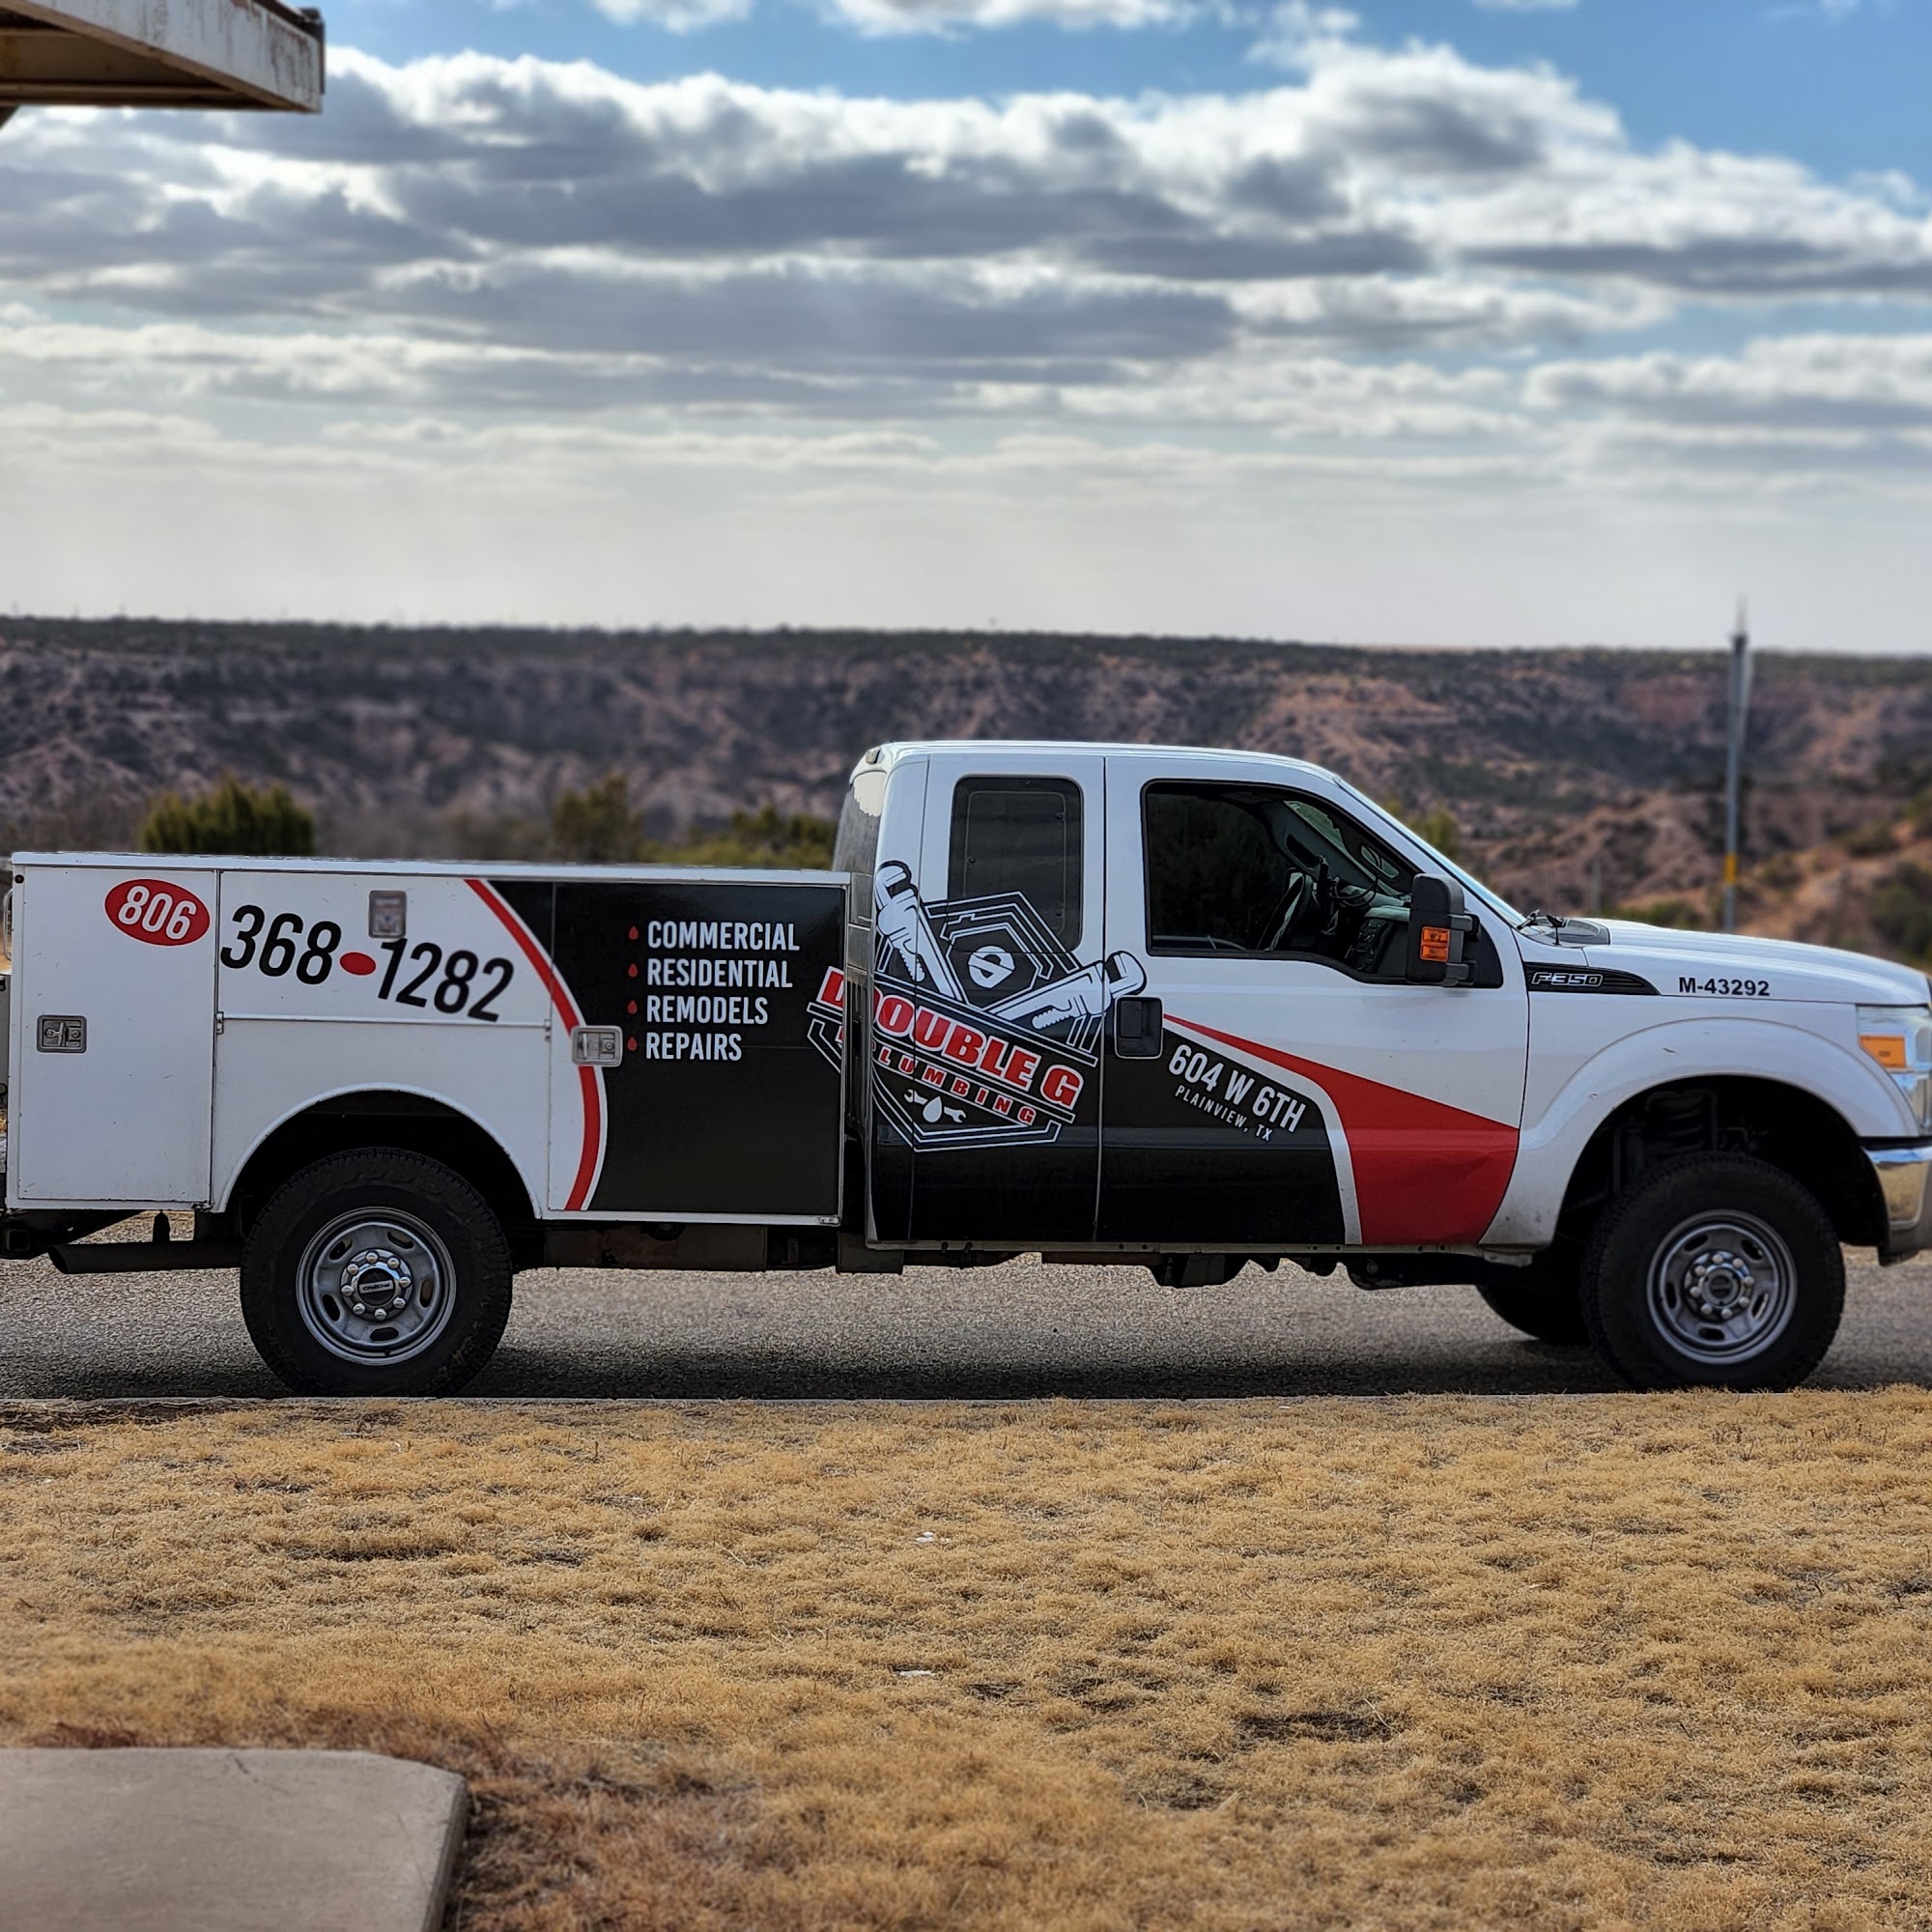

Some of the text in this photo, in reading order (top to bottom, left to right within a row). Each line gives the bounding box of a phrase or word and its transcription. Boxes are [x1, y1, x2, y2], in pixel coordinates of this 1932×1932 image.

[118, 886, 196, 940] 806
[647, 921, 800, 952] COMMERCIAL
[647, 958, 793, 988] RESIDENTIAL
[1531, 972, 1604, 987] F-350
[1679, 977, 1770, 997] M-43292
[646, 995, 768, 1024] REMODELS
[645, 1032, 742, 1061] REPAIRS
[835, 1026, 1037, 1126] LUMBING
[1039, 1064, 1085, 1111] G
[1168, 1044, 1306, 1133] 604 W 6TH
[1175, 1085, 1274, 1141] PLAINVIEW, TX
